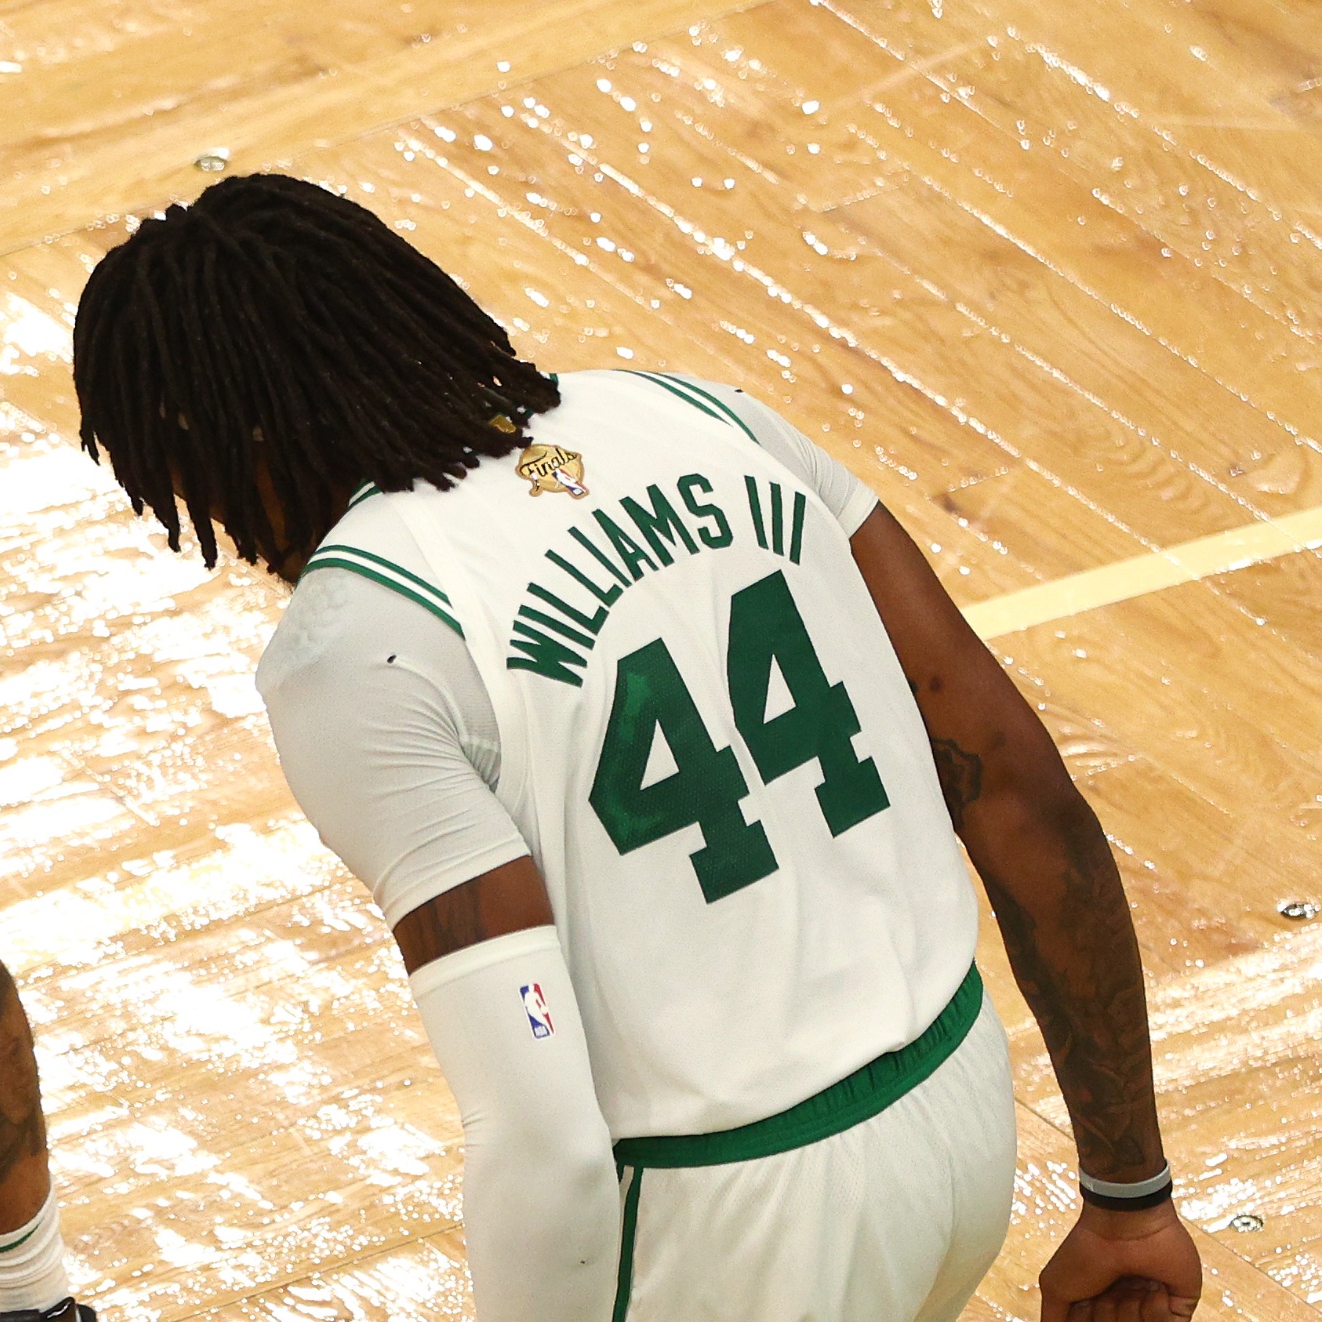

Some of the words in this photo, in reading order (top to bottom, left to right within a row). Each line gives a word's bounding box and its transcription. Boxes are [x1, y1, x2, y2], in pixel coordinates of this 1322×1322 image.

[519, 448, 578, 481] Finals
[506, 473, 733, 687] WILLIAMS
[744, 475, 806, 565] III
[588, 569, 891, 904] 44
